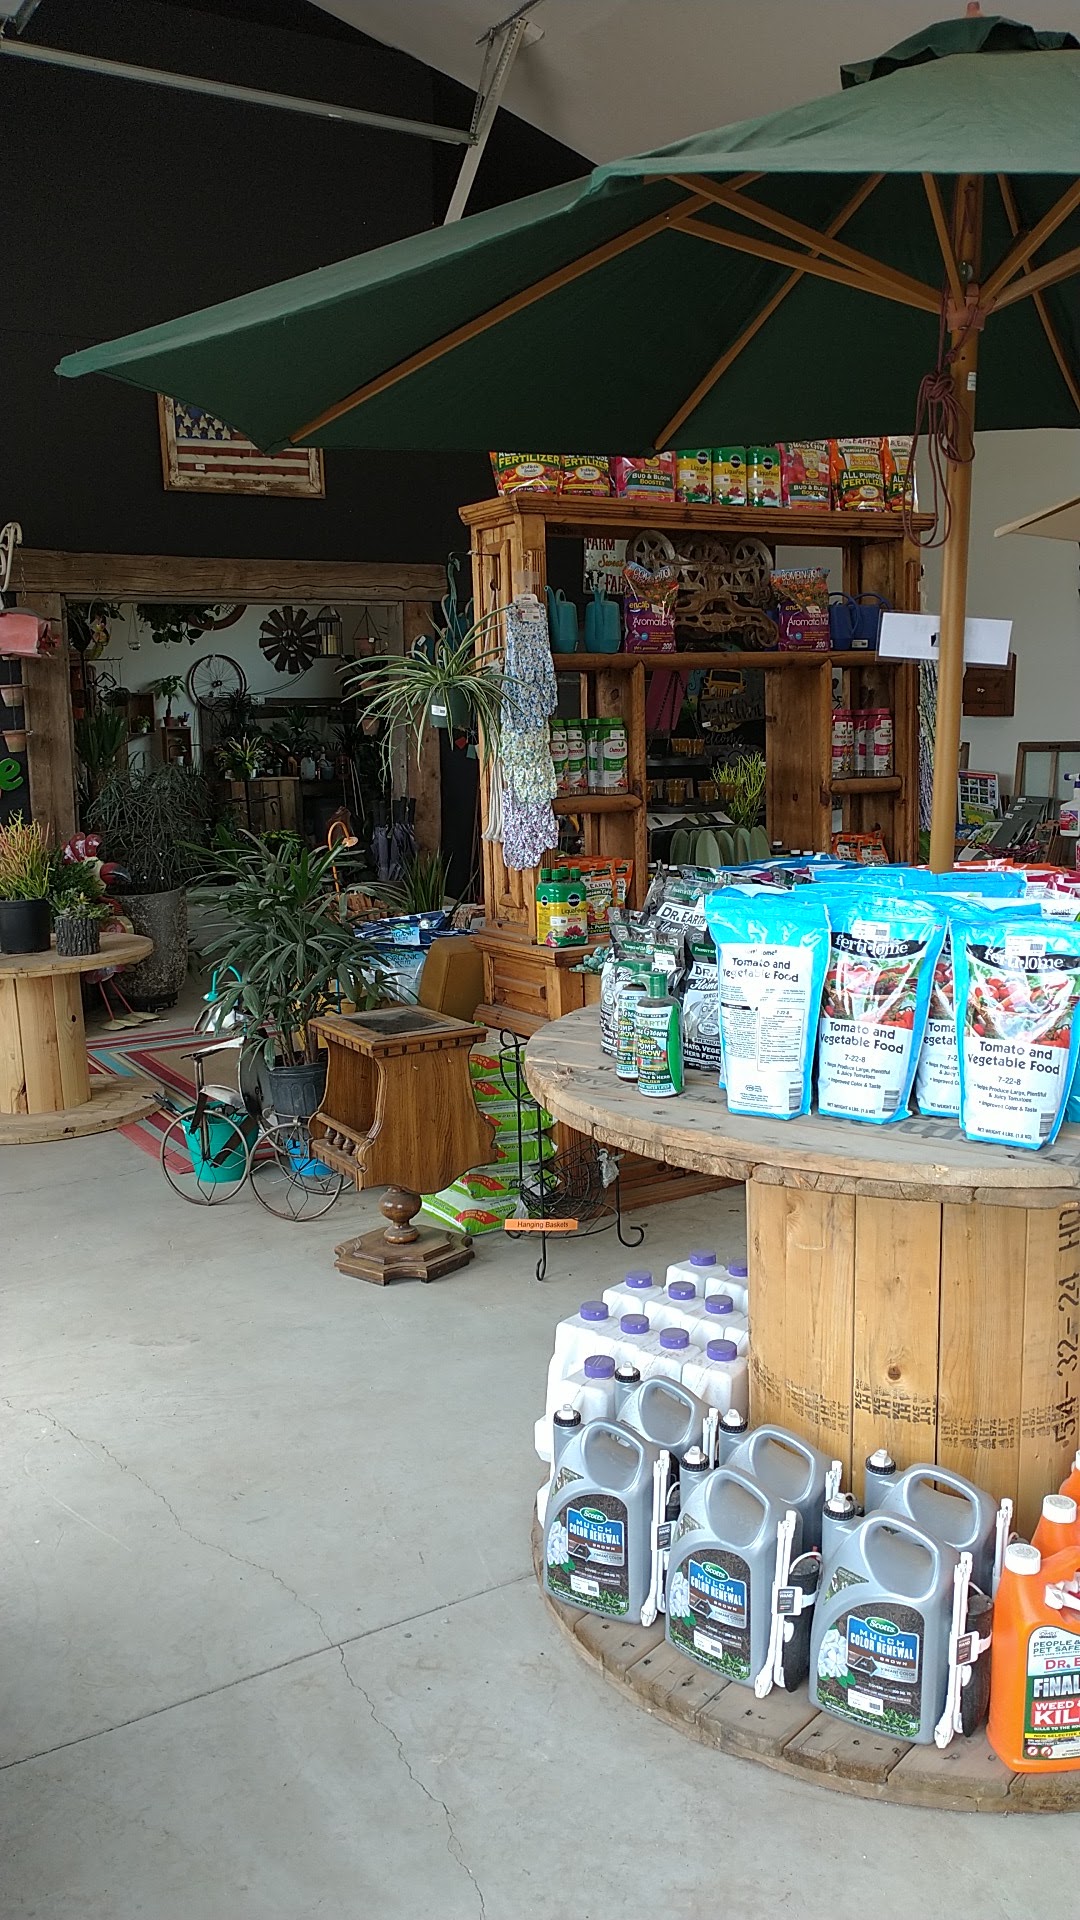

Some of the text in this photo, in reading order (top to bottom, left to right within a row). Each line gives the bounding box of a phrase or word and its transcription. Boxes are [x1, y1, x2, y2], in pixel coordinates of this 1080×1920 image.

[498, 453, 560, 468] FERTILIZER
[564, 456, 609, 473] ERTILIZER
[632, 471, 646, 480] BUD
[653, 473, 671, 482] BLOOM
[842, 471, 858, 480] ALL
[639, 478, 665, 487] BOOSTER
[586, 538, 616, 551] FARM
[632, 617, 668, 626] Aromatic
[788, 618, 820, 626] Aromatic
[589, 881, 612, 890] EARTH
[661, 906, 680, 921] DR.
[732, 957, 791, 970] Tomato and
[695, 966, 714, 977] DR.
[773, 970, 799, 983] Food
[639, 1018, 667, 1027] EARTH
[928, 1021, 955, 1033] Toma
[829, 1021, 896, 1040] Tomato and
[820, 1033, 904, 1055] Vegetable Food
[979, 1040, 1053, 1061] Tomato and
[684, 1049, 700, 1058] HERB
[844, 1053, 866, 1063] 7-22-8
[837, 1063, 855, 1071] Produce
[967, 1053, 1060, 1075] Vegetable Food
[998, 1075, 1022, 1086] 7-22-8
[988, 1085, 1009, 1094] Produce
[1008, 1095, 1032, 1103] Tomatoes
[985, 1128, 1002, 1136] WEIGHT
[517, 1221, 544, 1229] Hanging
[862, 1393, 872, 1414] HT
[873, 1397, 881, 1416] 574
[880, 1398, 892, 1419] HT
[892, 1401, 900, 1420] 574
[899, 1402, 911, 1423] HT
[912, 1404, 921, 1424] 574
[920, 1406, 931, 1426] HT
[583, 1509, 604, 1521] Scotts
[575, 1519, 612, 1534] MULCH
[569, 1522, 621, 1545] COLOR RENEWAL
[592, 1543, 616, 1551] BROWN
[705, 1564, 726, 1579] Scotts
[697, 1572, 734, 1593] MULCH
[690, 1575, 743, 1606] COLOR RENEWAL
[713, 1600, 737, 1612] BROWN
[869, 1619, 896, 1633] Scotts
[859, 1628, 905, 1647] MULCH
[1033, 1640, 1073, 1648] PEOPLE
[850, 1632, 915, 1660] COLOR RENEWAL
[879, 1656, 908, 1666] BROWN
[1045, 1659, 1071, 1670] DR.
[1035, 1700, 1075, 1711] WEED
[1034, 1709, 1080, 1725] KIL
